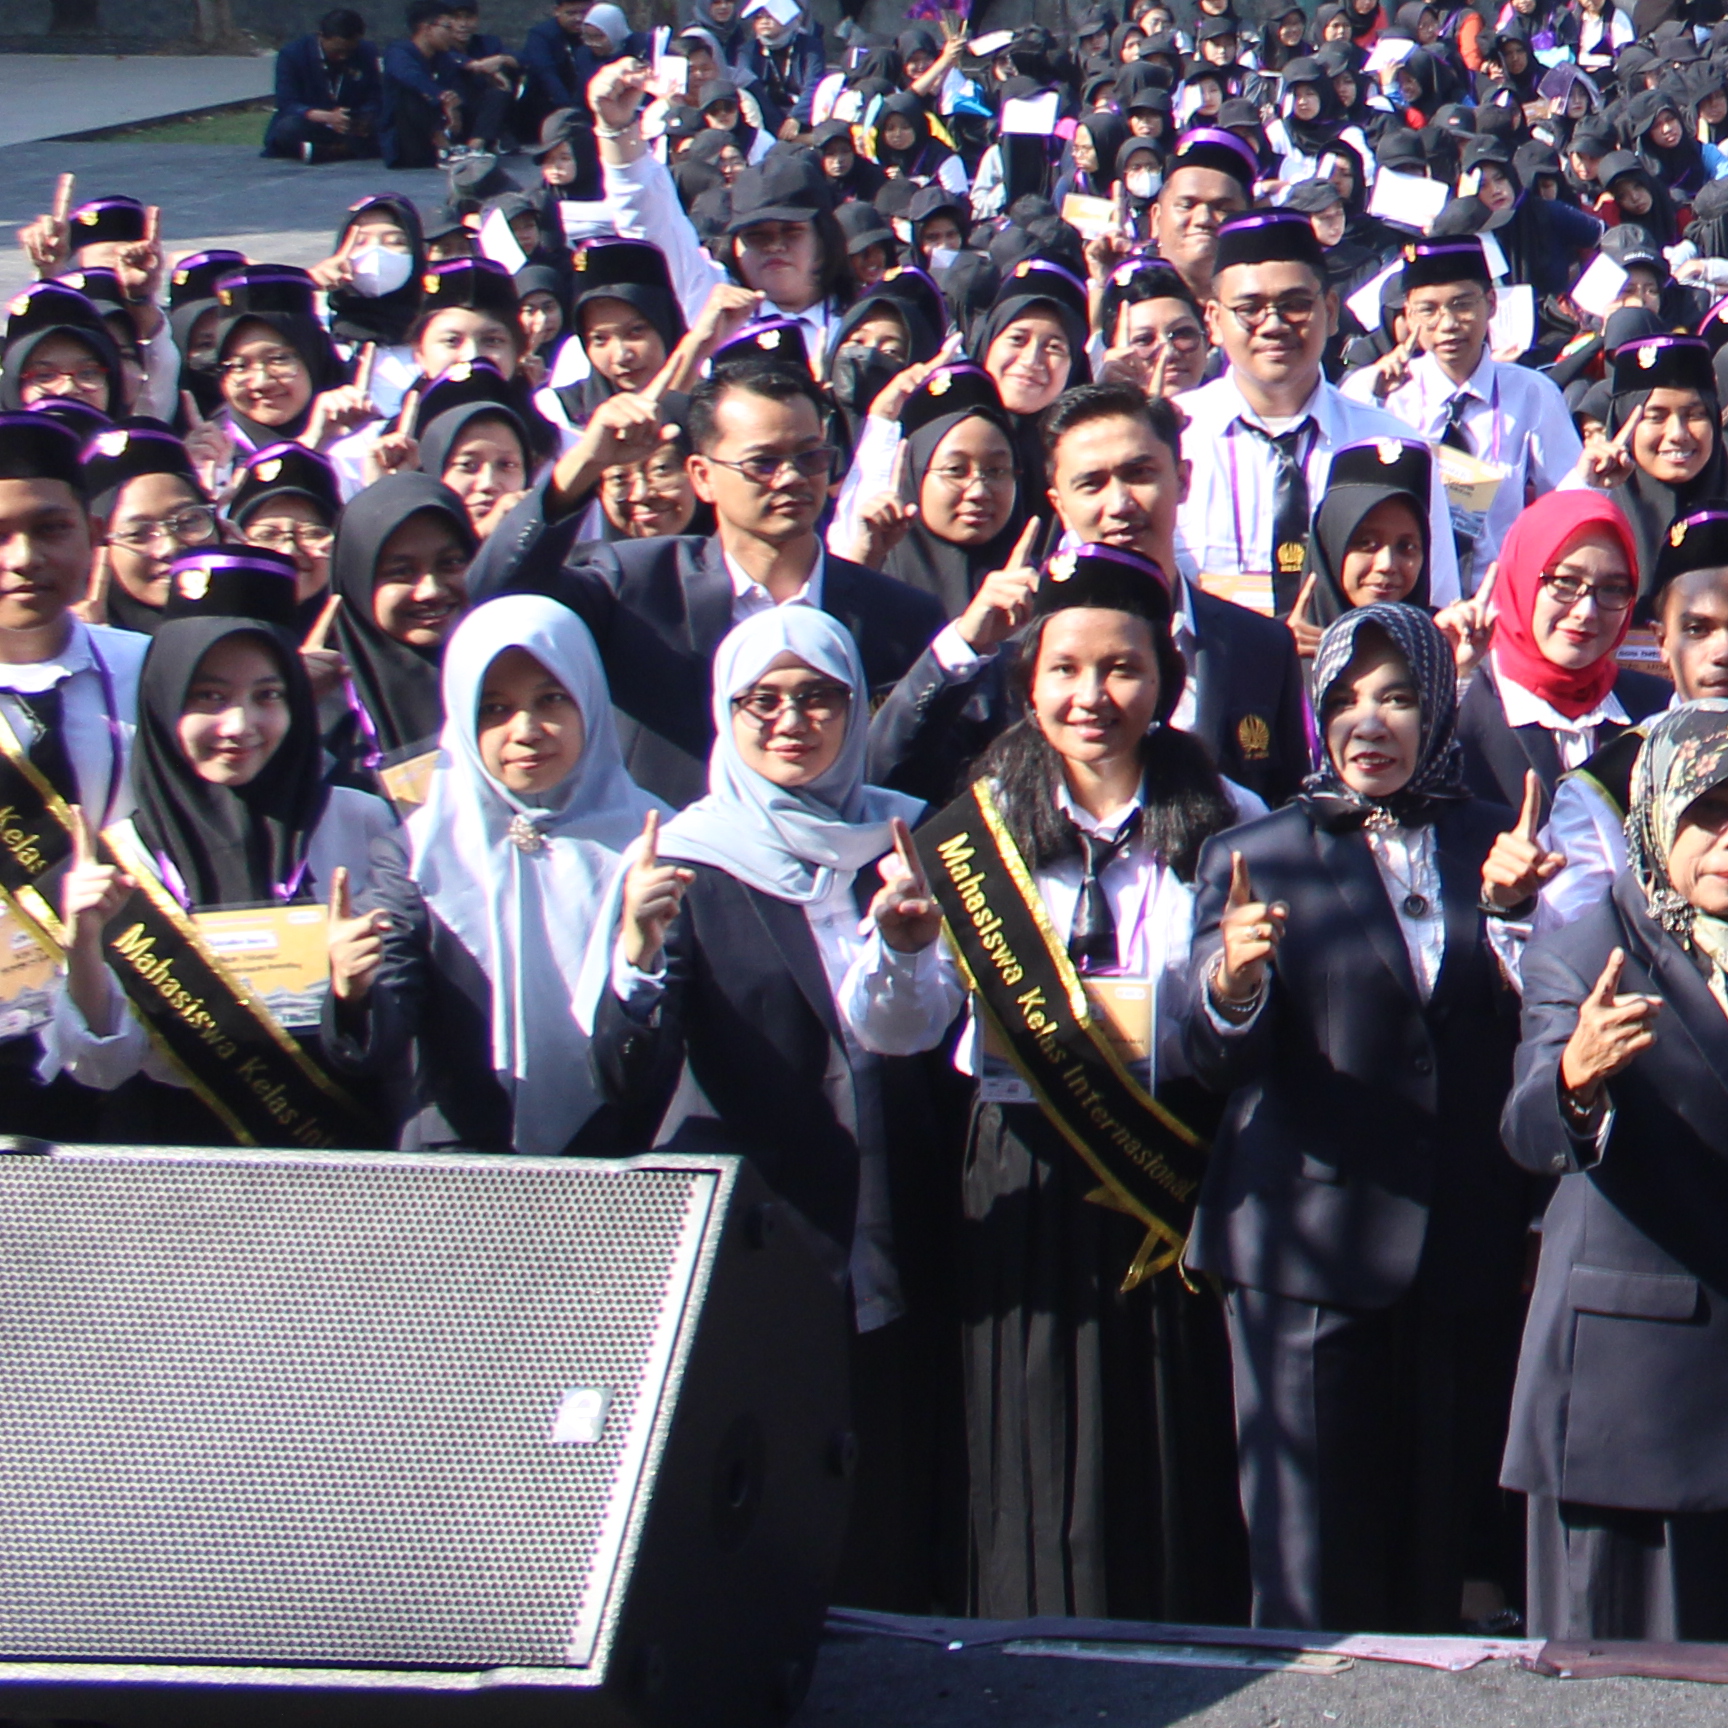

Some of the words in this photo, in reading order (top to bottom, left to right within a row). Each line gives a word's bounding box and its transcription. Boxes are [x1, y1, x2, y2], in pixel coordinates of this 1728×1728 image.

[110, 922, 238, 1059] Mahasiswa
[235, 1054, 300, 1125] Kelas
[936, 831, 1024, 986] Mahasiswa
[1016, 985, 1067, 1064] Kelas
[1062, 1064, 1198, 1204] Internasional
